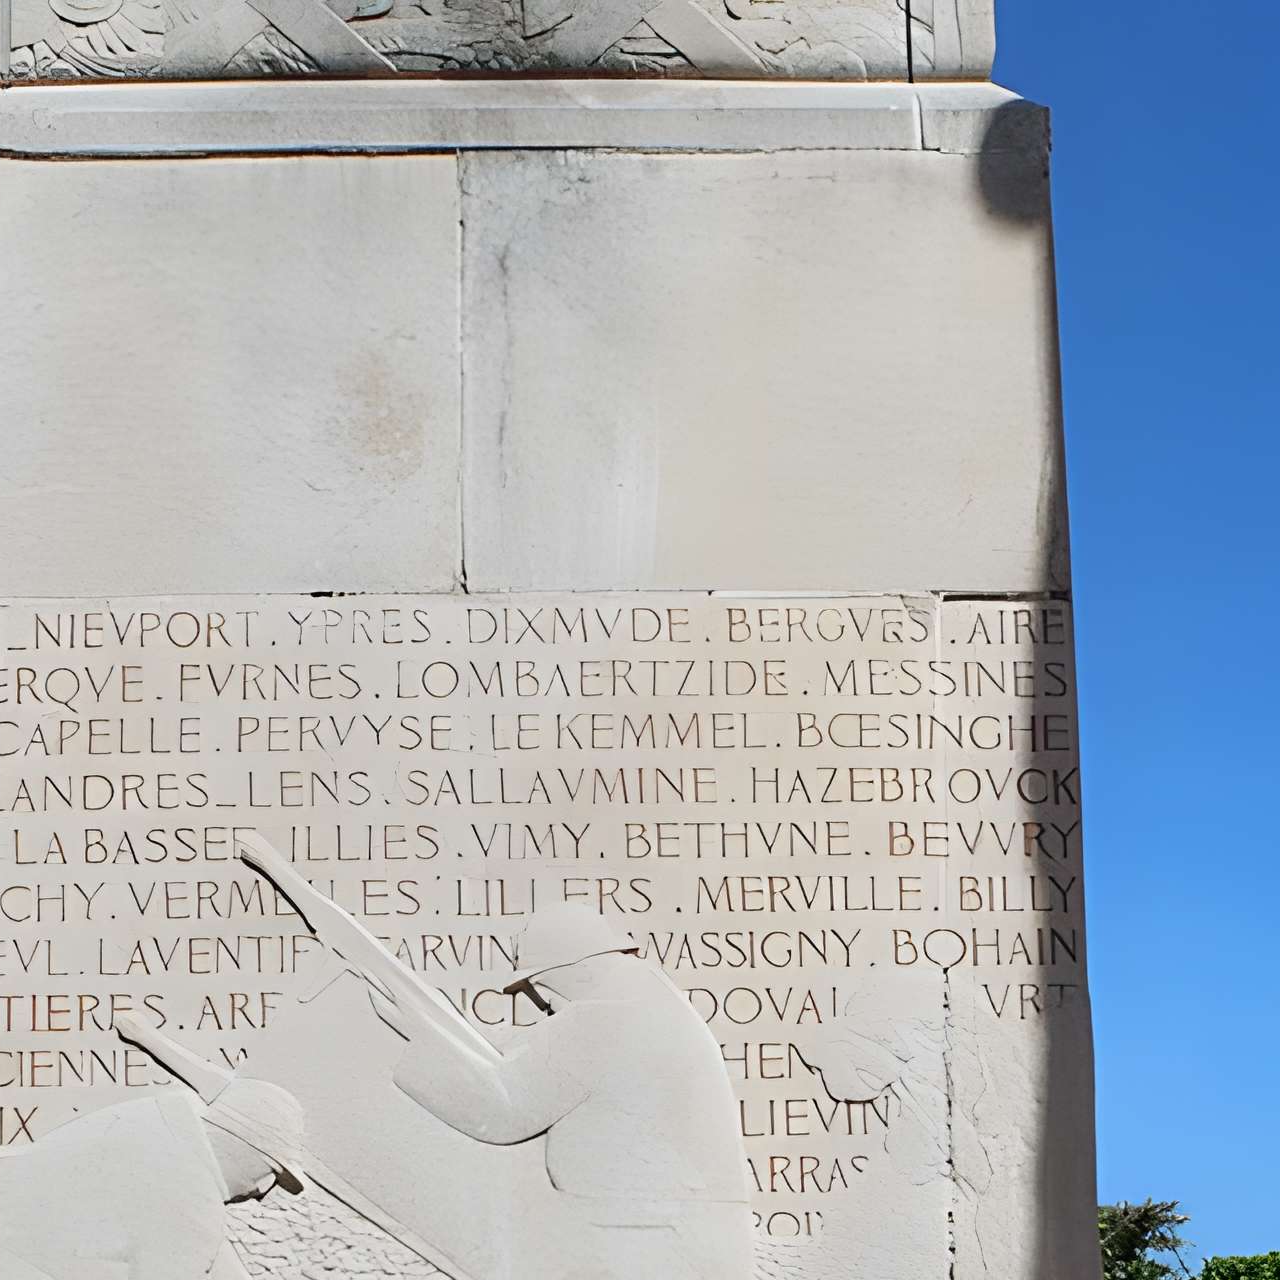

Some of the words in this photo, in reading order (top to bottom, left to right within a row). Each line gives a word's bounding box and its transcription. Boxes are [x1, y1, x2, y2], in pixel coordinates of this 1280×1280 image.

[967, 609, 1064, 644] AIRE
[824, 659, 1067, 697] MESSINES
[491, 714, 540, 750] LE
[13, 829, 67, 864] LA
[888, 820, 1078, 859] BEVVRY
[960, 875, 1075, 913] BILLY
[378, 935, 520, 972] ARVIN
[892, 928, 1076, 969] BOHAIN
